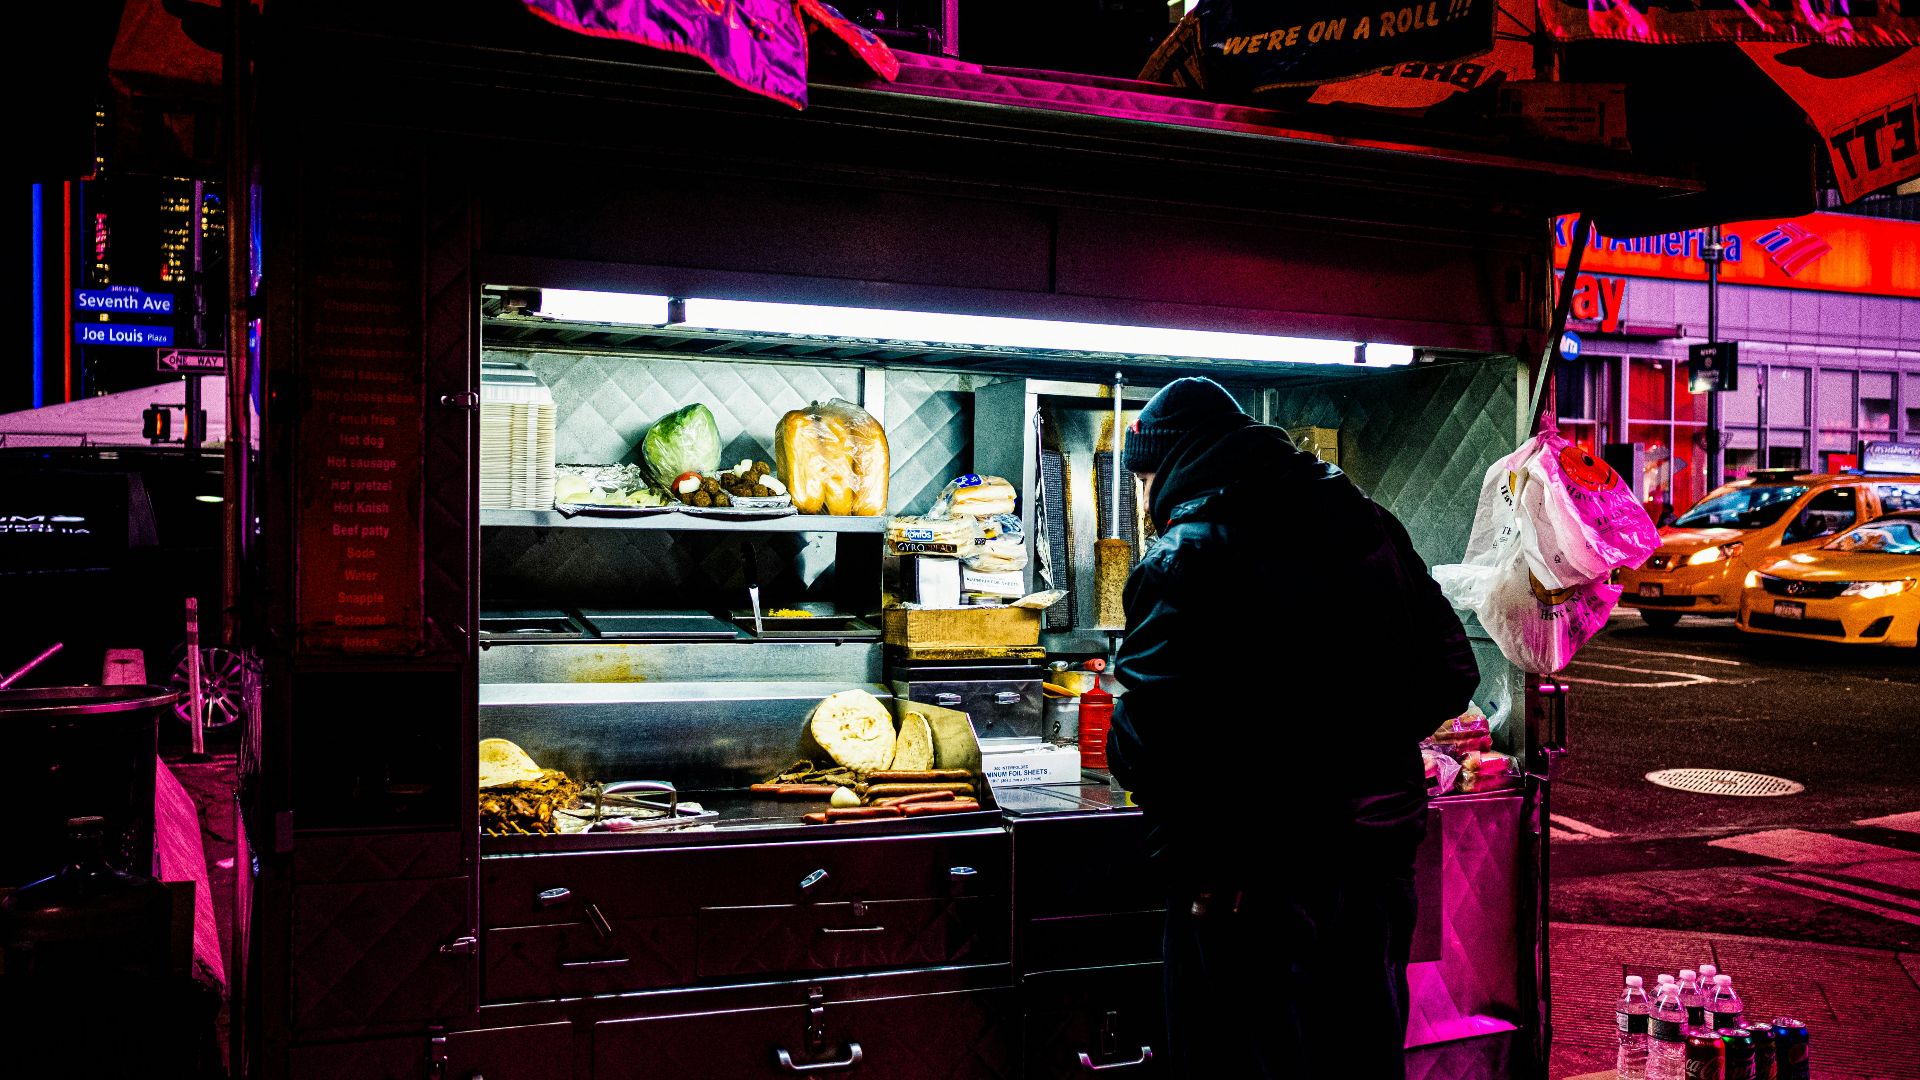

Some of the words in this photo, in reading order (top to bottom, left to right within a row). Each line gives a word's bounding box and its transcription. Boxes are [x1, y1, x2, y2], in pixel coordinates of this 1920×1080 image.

[1222, 25, 1301, 56] WE'RE
[1308, 17, 1347, 43] ON
[1353, 16, 1371, 40] A
[1380, 1, 1440, 38] ROLL
[79, 293, 138, 309] Seventh
[143, 297, 170, 311] Ave
[83, 327, 105, 341] Joe
[109, 328, 143, 343] Louis
[147, 333, 167, 342] Plaza
[169, 355, 187, 365] ONE
[197, 355, 218, 366] WAY
[328, 412, 368, 426] Fench
[371, 413, 397, 426] fries
[340, 433, 360, 446] Hot
[363, 434, 385, 449] dog
[327, 455, 347, 468] Hot
[350, 458, 398, 472] sausage
[331, 479, 351, 492] Hot
[354, 480, 393, 495] pretzel
[334, 502, 354, 514] Hot
[357, 501, 390, 514] Knish
[333, 524, 360, 536] Beef
[363, 525, 391, 539] patty
[347, 548, 376, 559] Soda
[898, 543, 925, 552] GYRO
[345, 570, 378, 582] Water
[1540, 608, 1564, 621] Have
[1023, 768, 1048, 776] SHEETS
